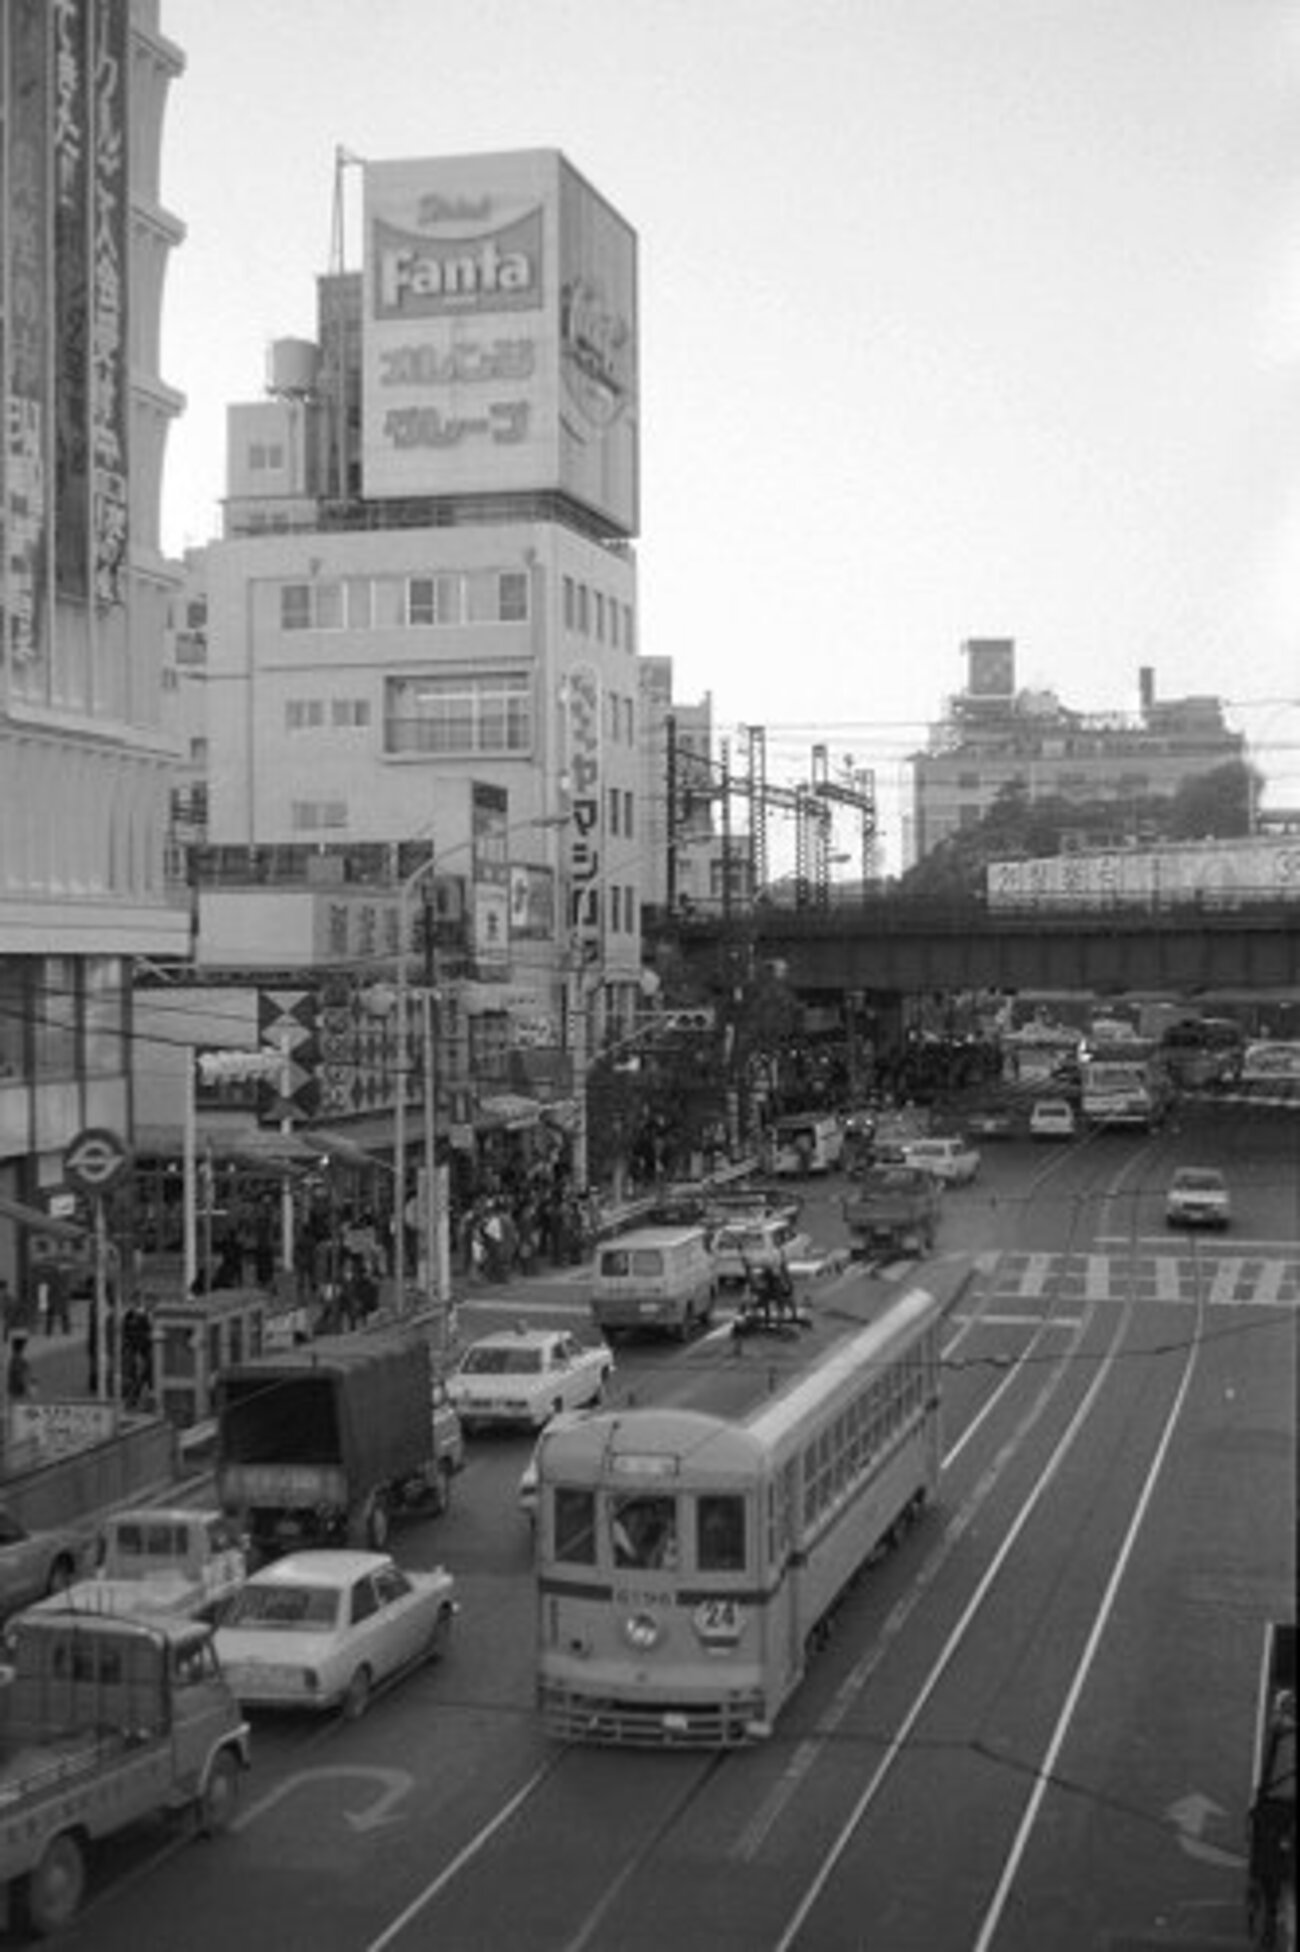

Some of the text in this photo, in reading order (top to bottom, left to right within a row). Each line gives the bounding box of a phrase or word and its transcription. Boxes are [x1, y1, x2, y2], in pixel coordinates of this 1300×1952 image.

[381, 240, 531, 307] Fanta
[379, 338, 536, 387] オレンジ
[383, 399, 531, 449] グレープ
[705, 1601, 735, 1628] 24
